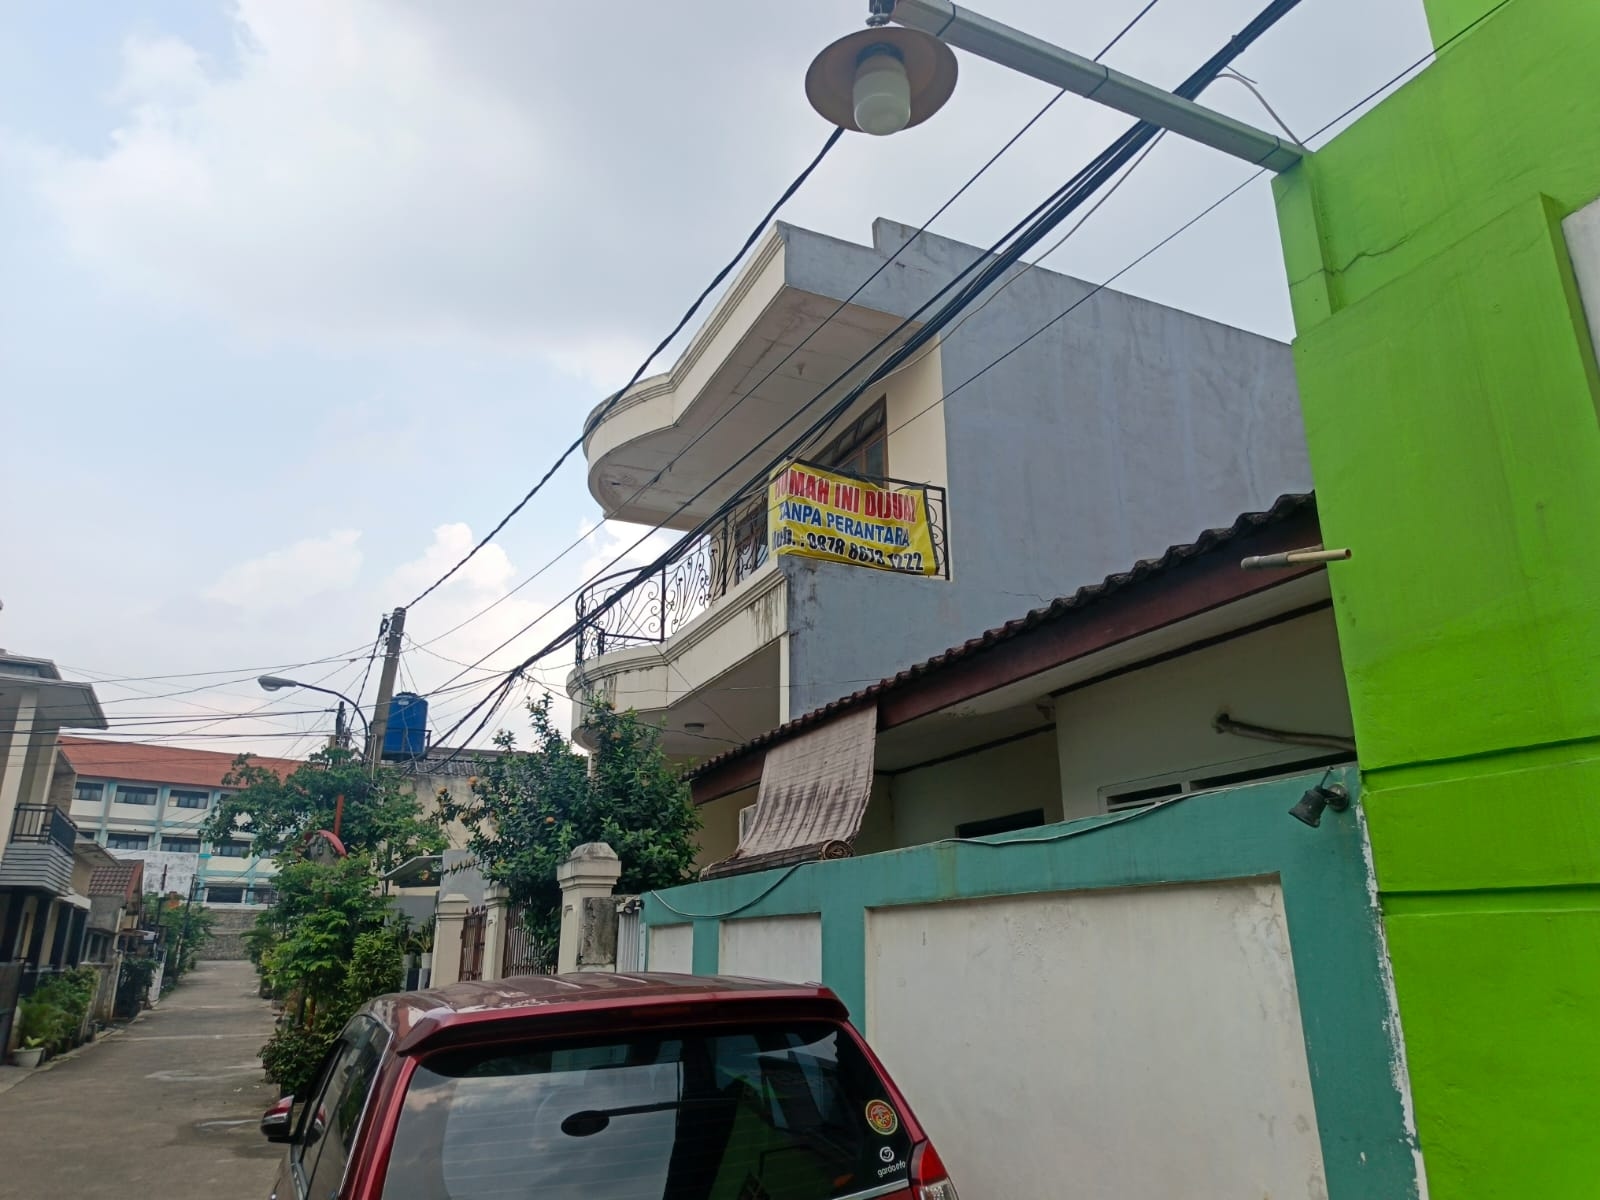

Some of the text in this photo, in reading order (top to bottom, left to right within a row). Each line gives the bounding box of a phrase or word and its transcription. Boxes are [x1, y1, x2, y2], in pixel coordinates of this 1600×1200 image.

[778, 501, 910, 547] TANPA PERANTARA
[834, 483, 860, 513] INI
[864, 489, 917, 523] DIJUAL
